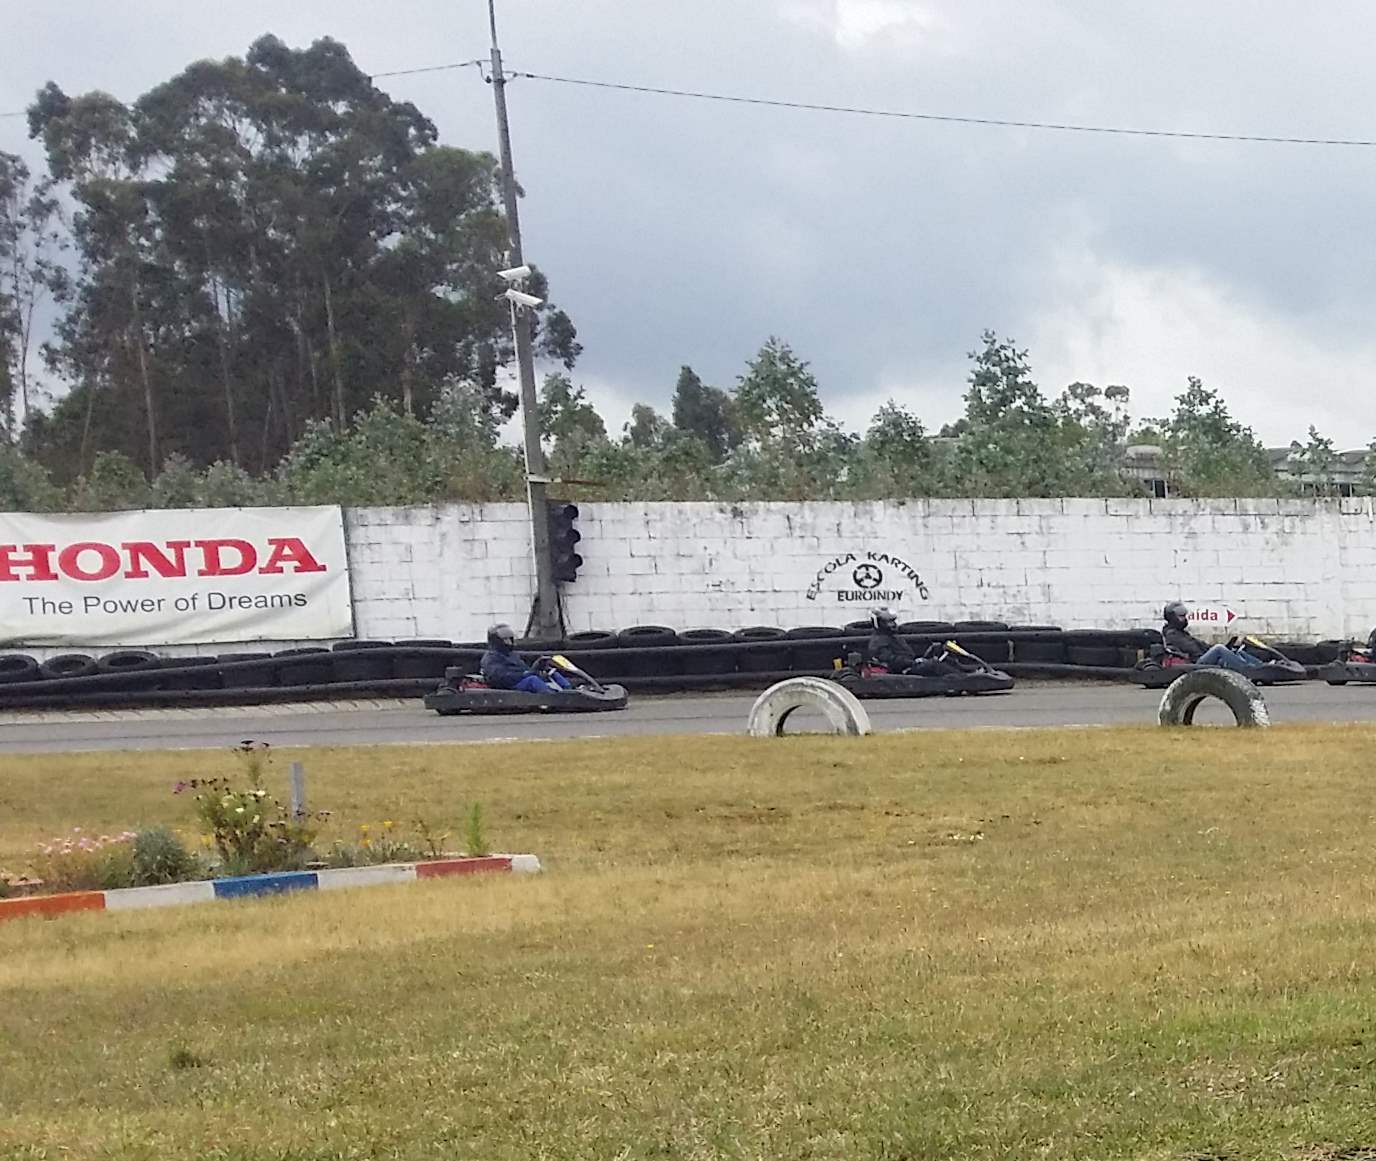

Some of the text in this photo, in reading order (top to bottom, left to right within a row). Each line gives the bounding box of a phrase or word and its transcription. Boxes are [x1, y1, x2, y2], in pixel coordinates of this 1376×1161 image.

[0, 537, 327, 582] HONDA
[806, 551, 929, 600] ESCOLA KARTING
[23, 591, 308, 615] The Power of Dreams
[838, 590, 903, 601] EUROINDY
[1188, 608, 1218, 621] aída
